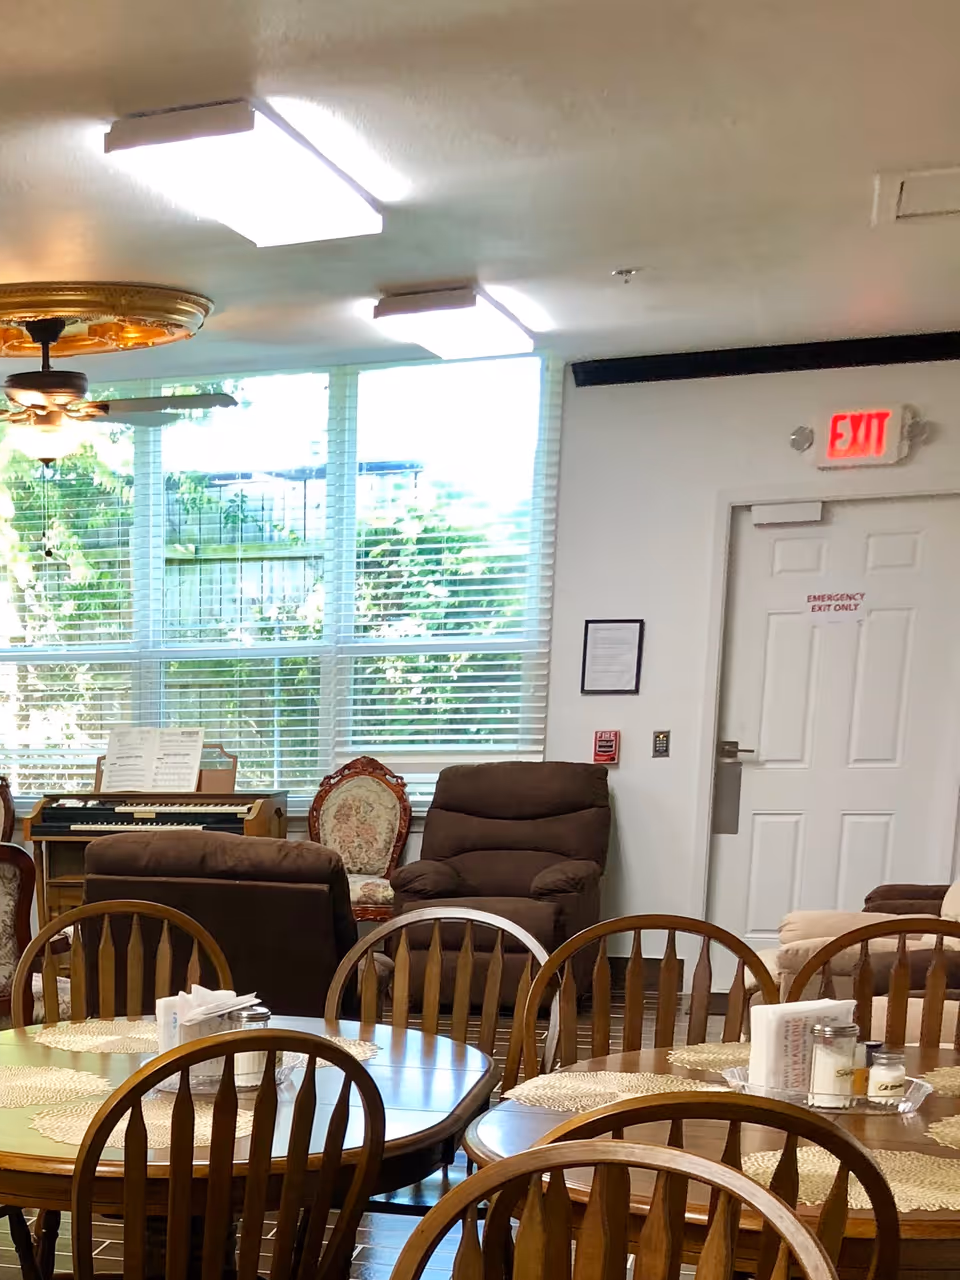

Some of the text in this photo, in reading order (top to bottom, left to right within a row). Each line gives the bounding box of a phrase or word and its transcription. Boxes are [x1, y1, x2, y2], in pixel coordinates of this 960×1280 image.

[827, 412, 891, 459] EXIT
[807, 592, 865, 603] EMERGENCY
[811, 603, 860, 613] EXIT ONLY
[596, 731, 616, 740] FIRE
